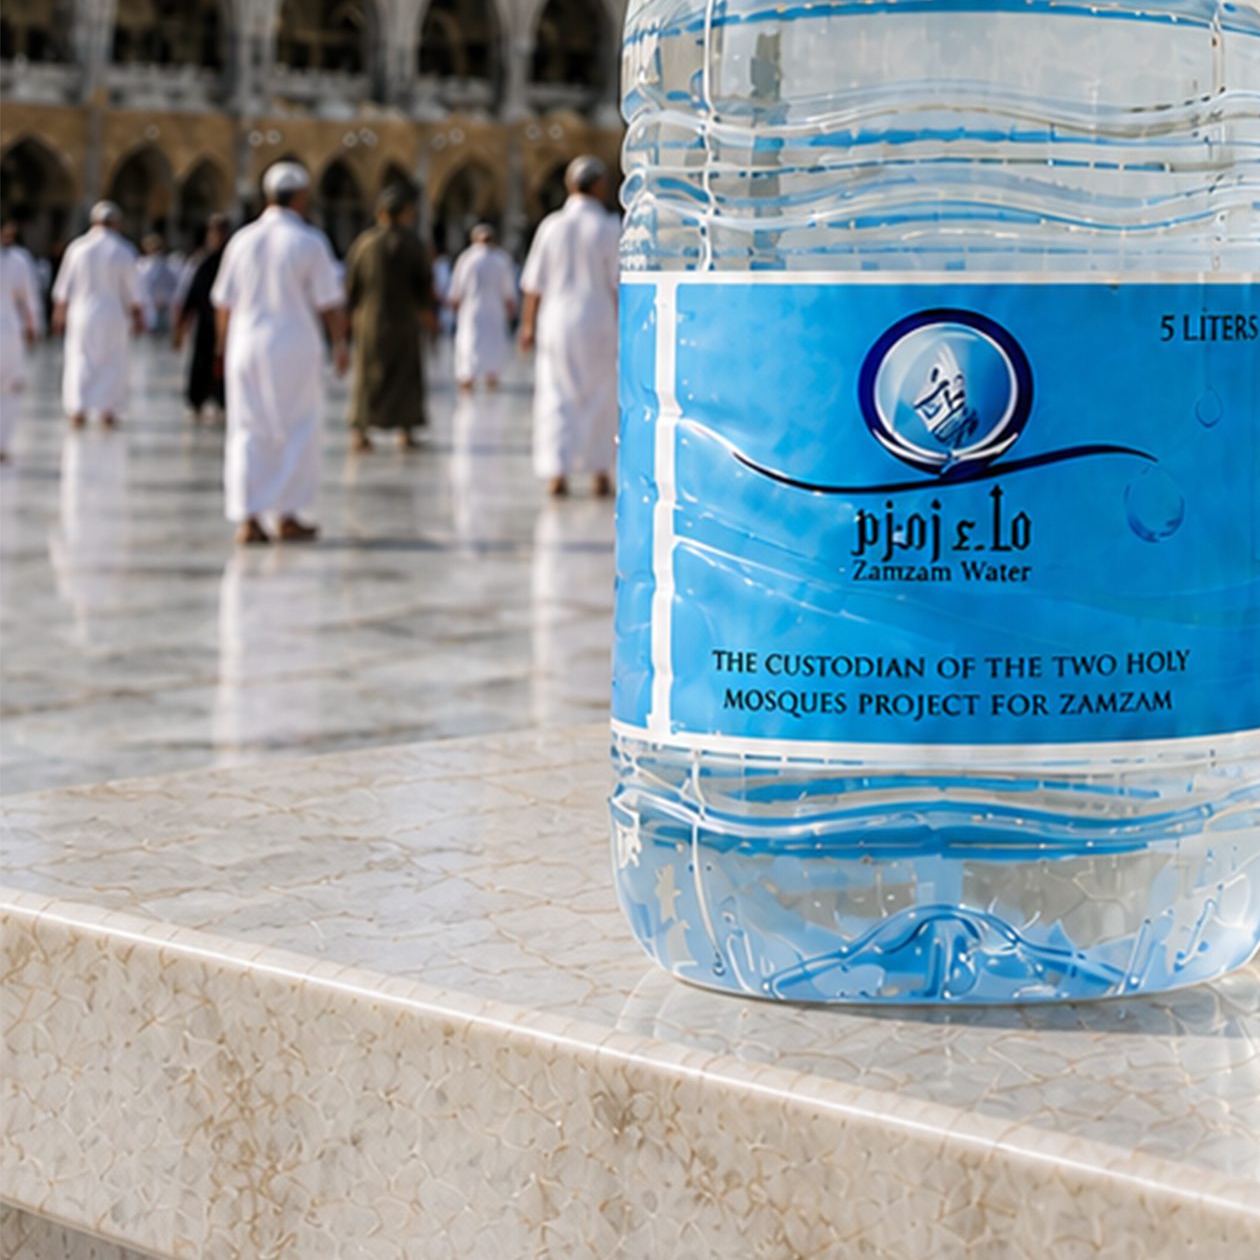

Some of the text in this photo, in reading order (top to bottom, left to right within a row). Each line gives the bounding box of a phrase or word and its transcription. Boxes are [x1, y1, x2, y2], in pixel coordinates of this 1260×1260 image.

[1161, 315, 1175, 342] 5
[853, 559, 1032, 582] Zamzam Water
[712, 649, 1190, 680] THE CUSTODIAN OF THE TWO HOLY
[724, 688, 1172, 722] MOSQUES PROJECT FOR ZAMZAM
